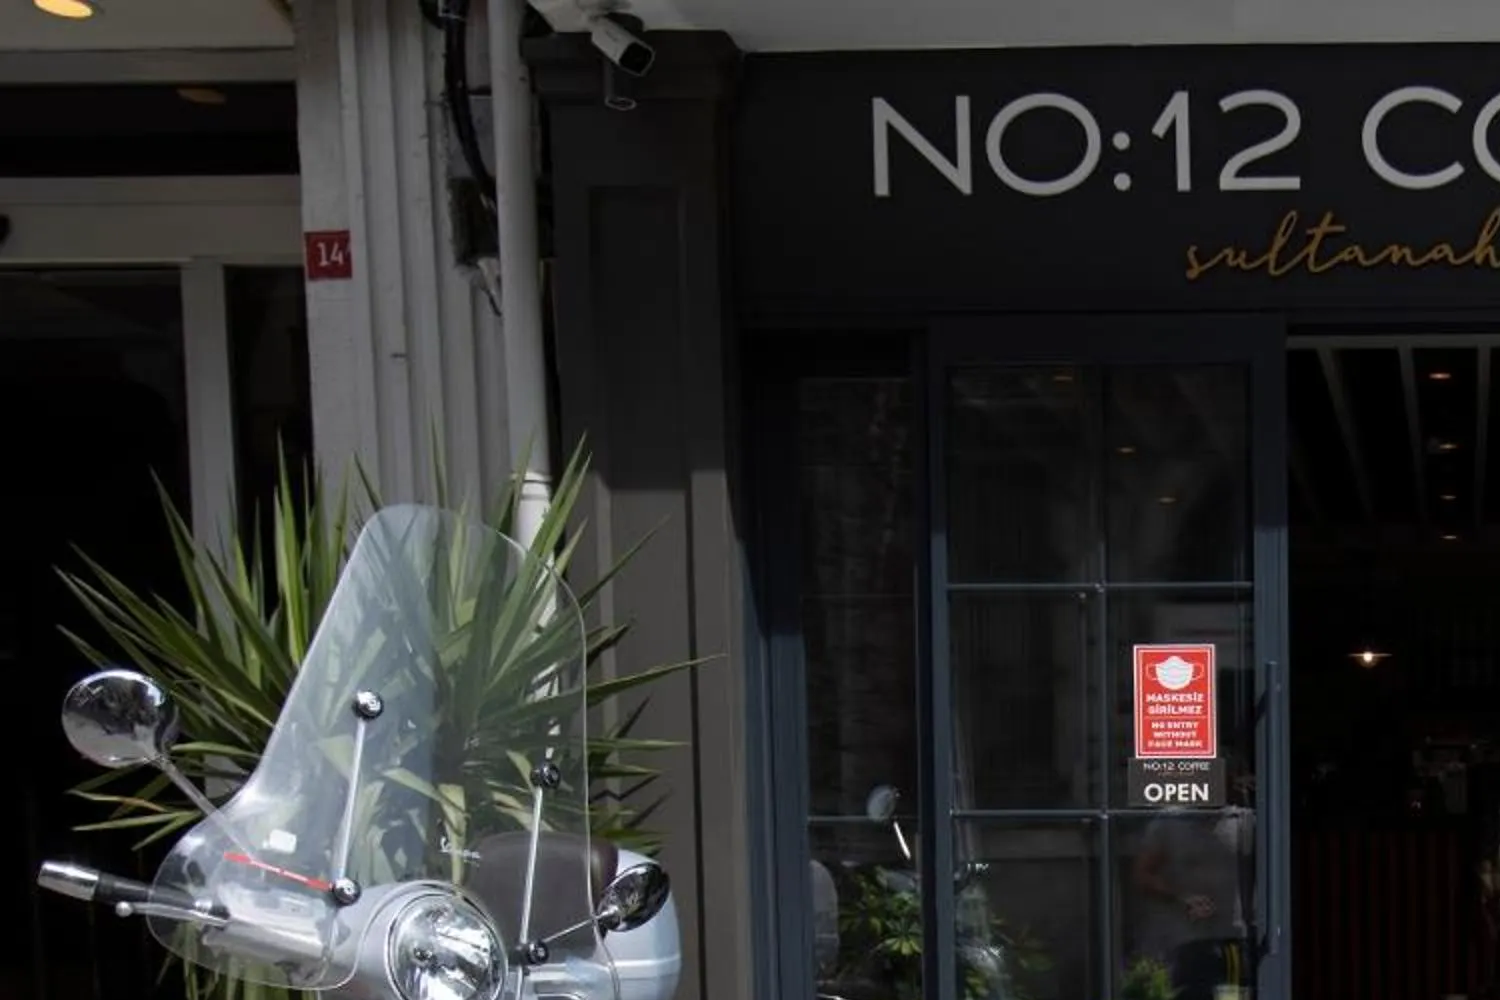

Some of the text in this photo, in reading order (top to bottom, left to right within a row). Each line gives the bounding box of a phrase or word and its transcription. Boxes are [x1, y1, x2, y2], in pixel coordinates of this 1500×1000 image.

[872, 89, 1302, 197] NO:12
[316, 241, 345, 267] 14
[1168, 721, 1199, 729] ENTRY
[1177, 761, 1211, 771] COFFEE
[1144, 783, 1209, 802] OPEN
